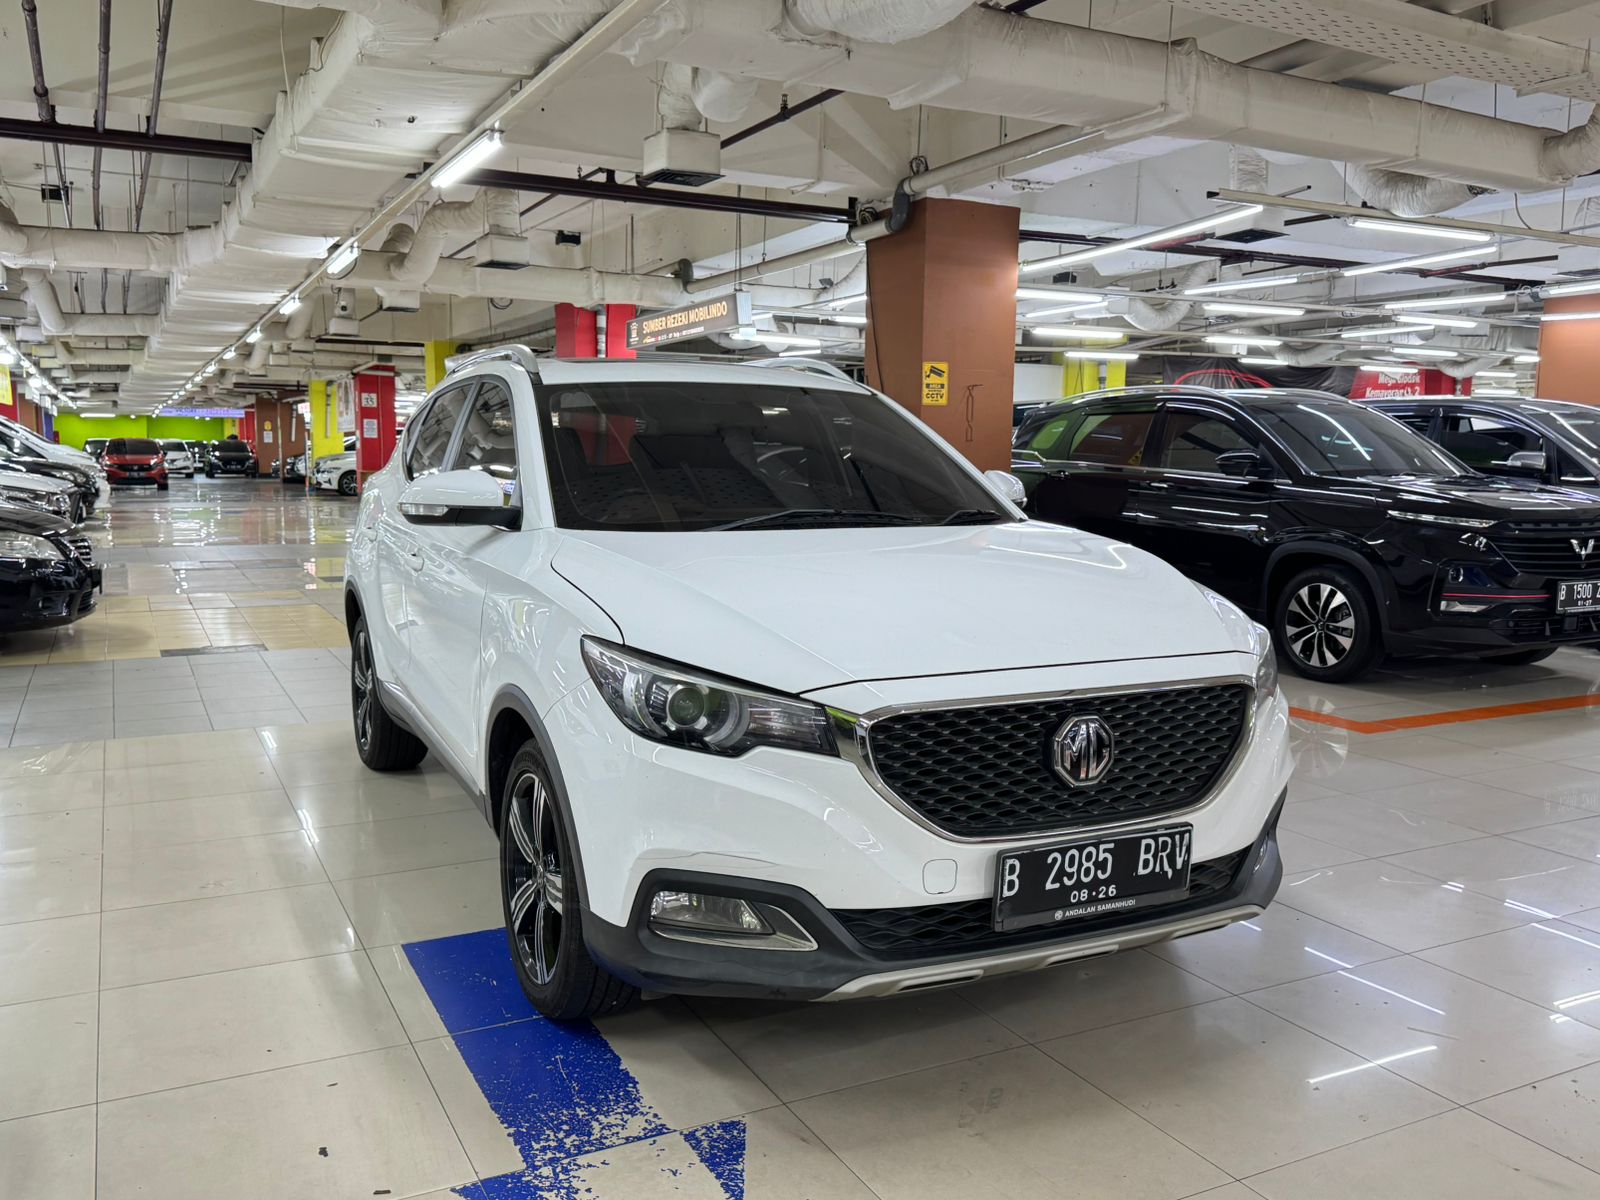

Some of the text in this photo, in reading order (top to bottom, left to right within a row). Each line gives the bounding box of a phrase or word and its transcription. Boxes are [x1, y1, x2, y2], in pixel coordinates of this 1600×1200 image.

[642, 315, 666, 334] SUMBER
[666, 310, 689, 328] REZEKI
[689, 301, 728, 325] MOBILINDO
[925, 392, 944, 400] CCTV
[1560, 585, 1567, 601] B
[1573, 583, 1593, 600] 1500
[1062, 719, 1112, 782] MG
[1002, 833, 1190, 898] B 2985 BRV
[1064, 899, 1136, 918] ANDALAN SAMANHUDI
